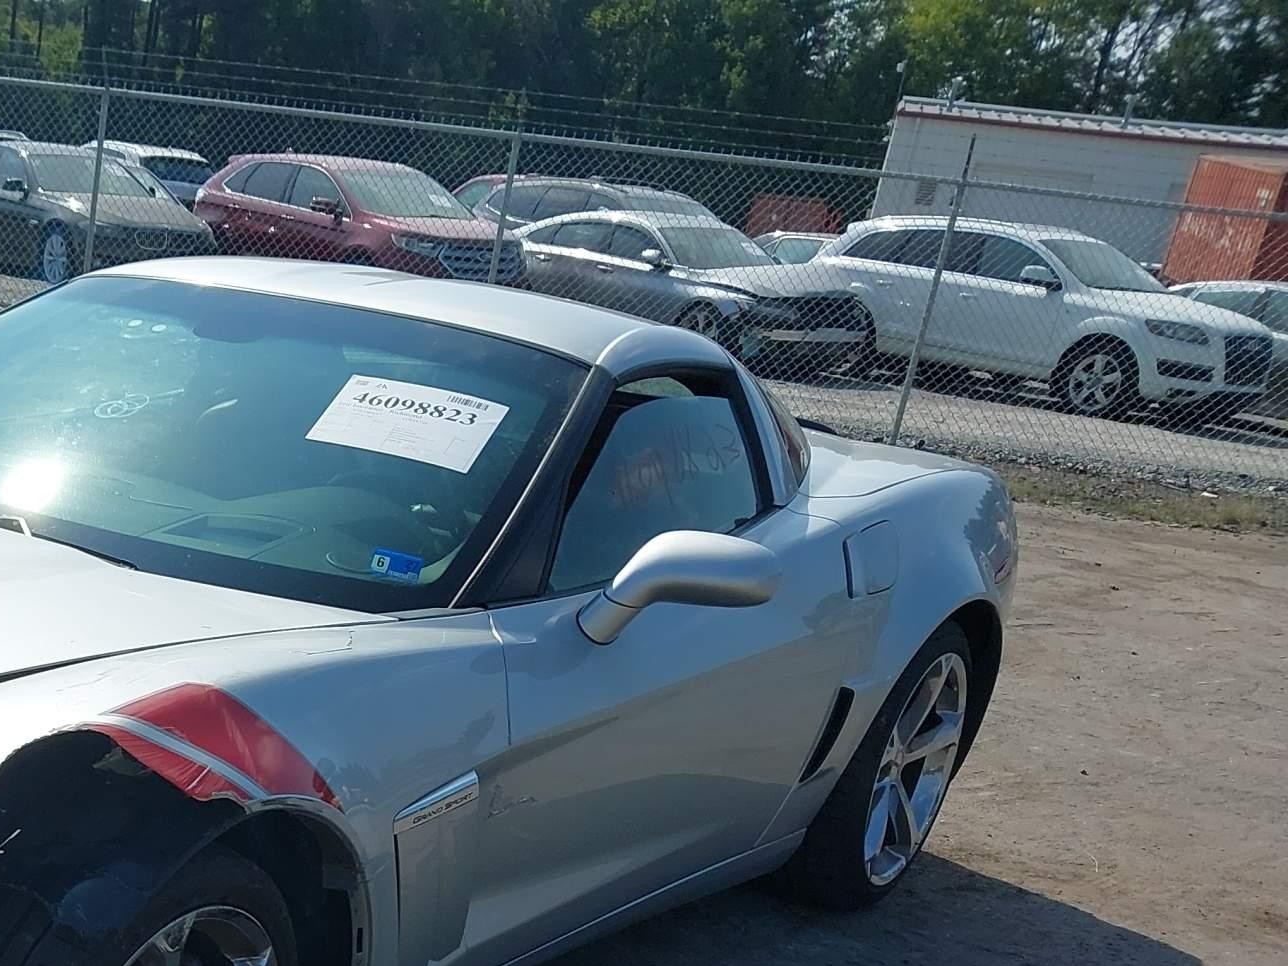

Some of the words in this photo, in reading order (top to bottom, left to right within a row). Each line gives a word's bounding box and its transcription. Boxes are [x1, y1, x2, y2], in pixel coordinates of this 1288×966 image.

[353, 391, 478, 427] 46098823
[377, 556, 385, 568] 6
[412, 806, 443, 825] GRAND
[443, 791, 474, 812] SPORT
